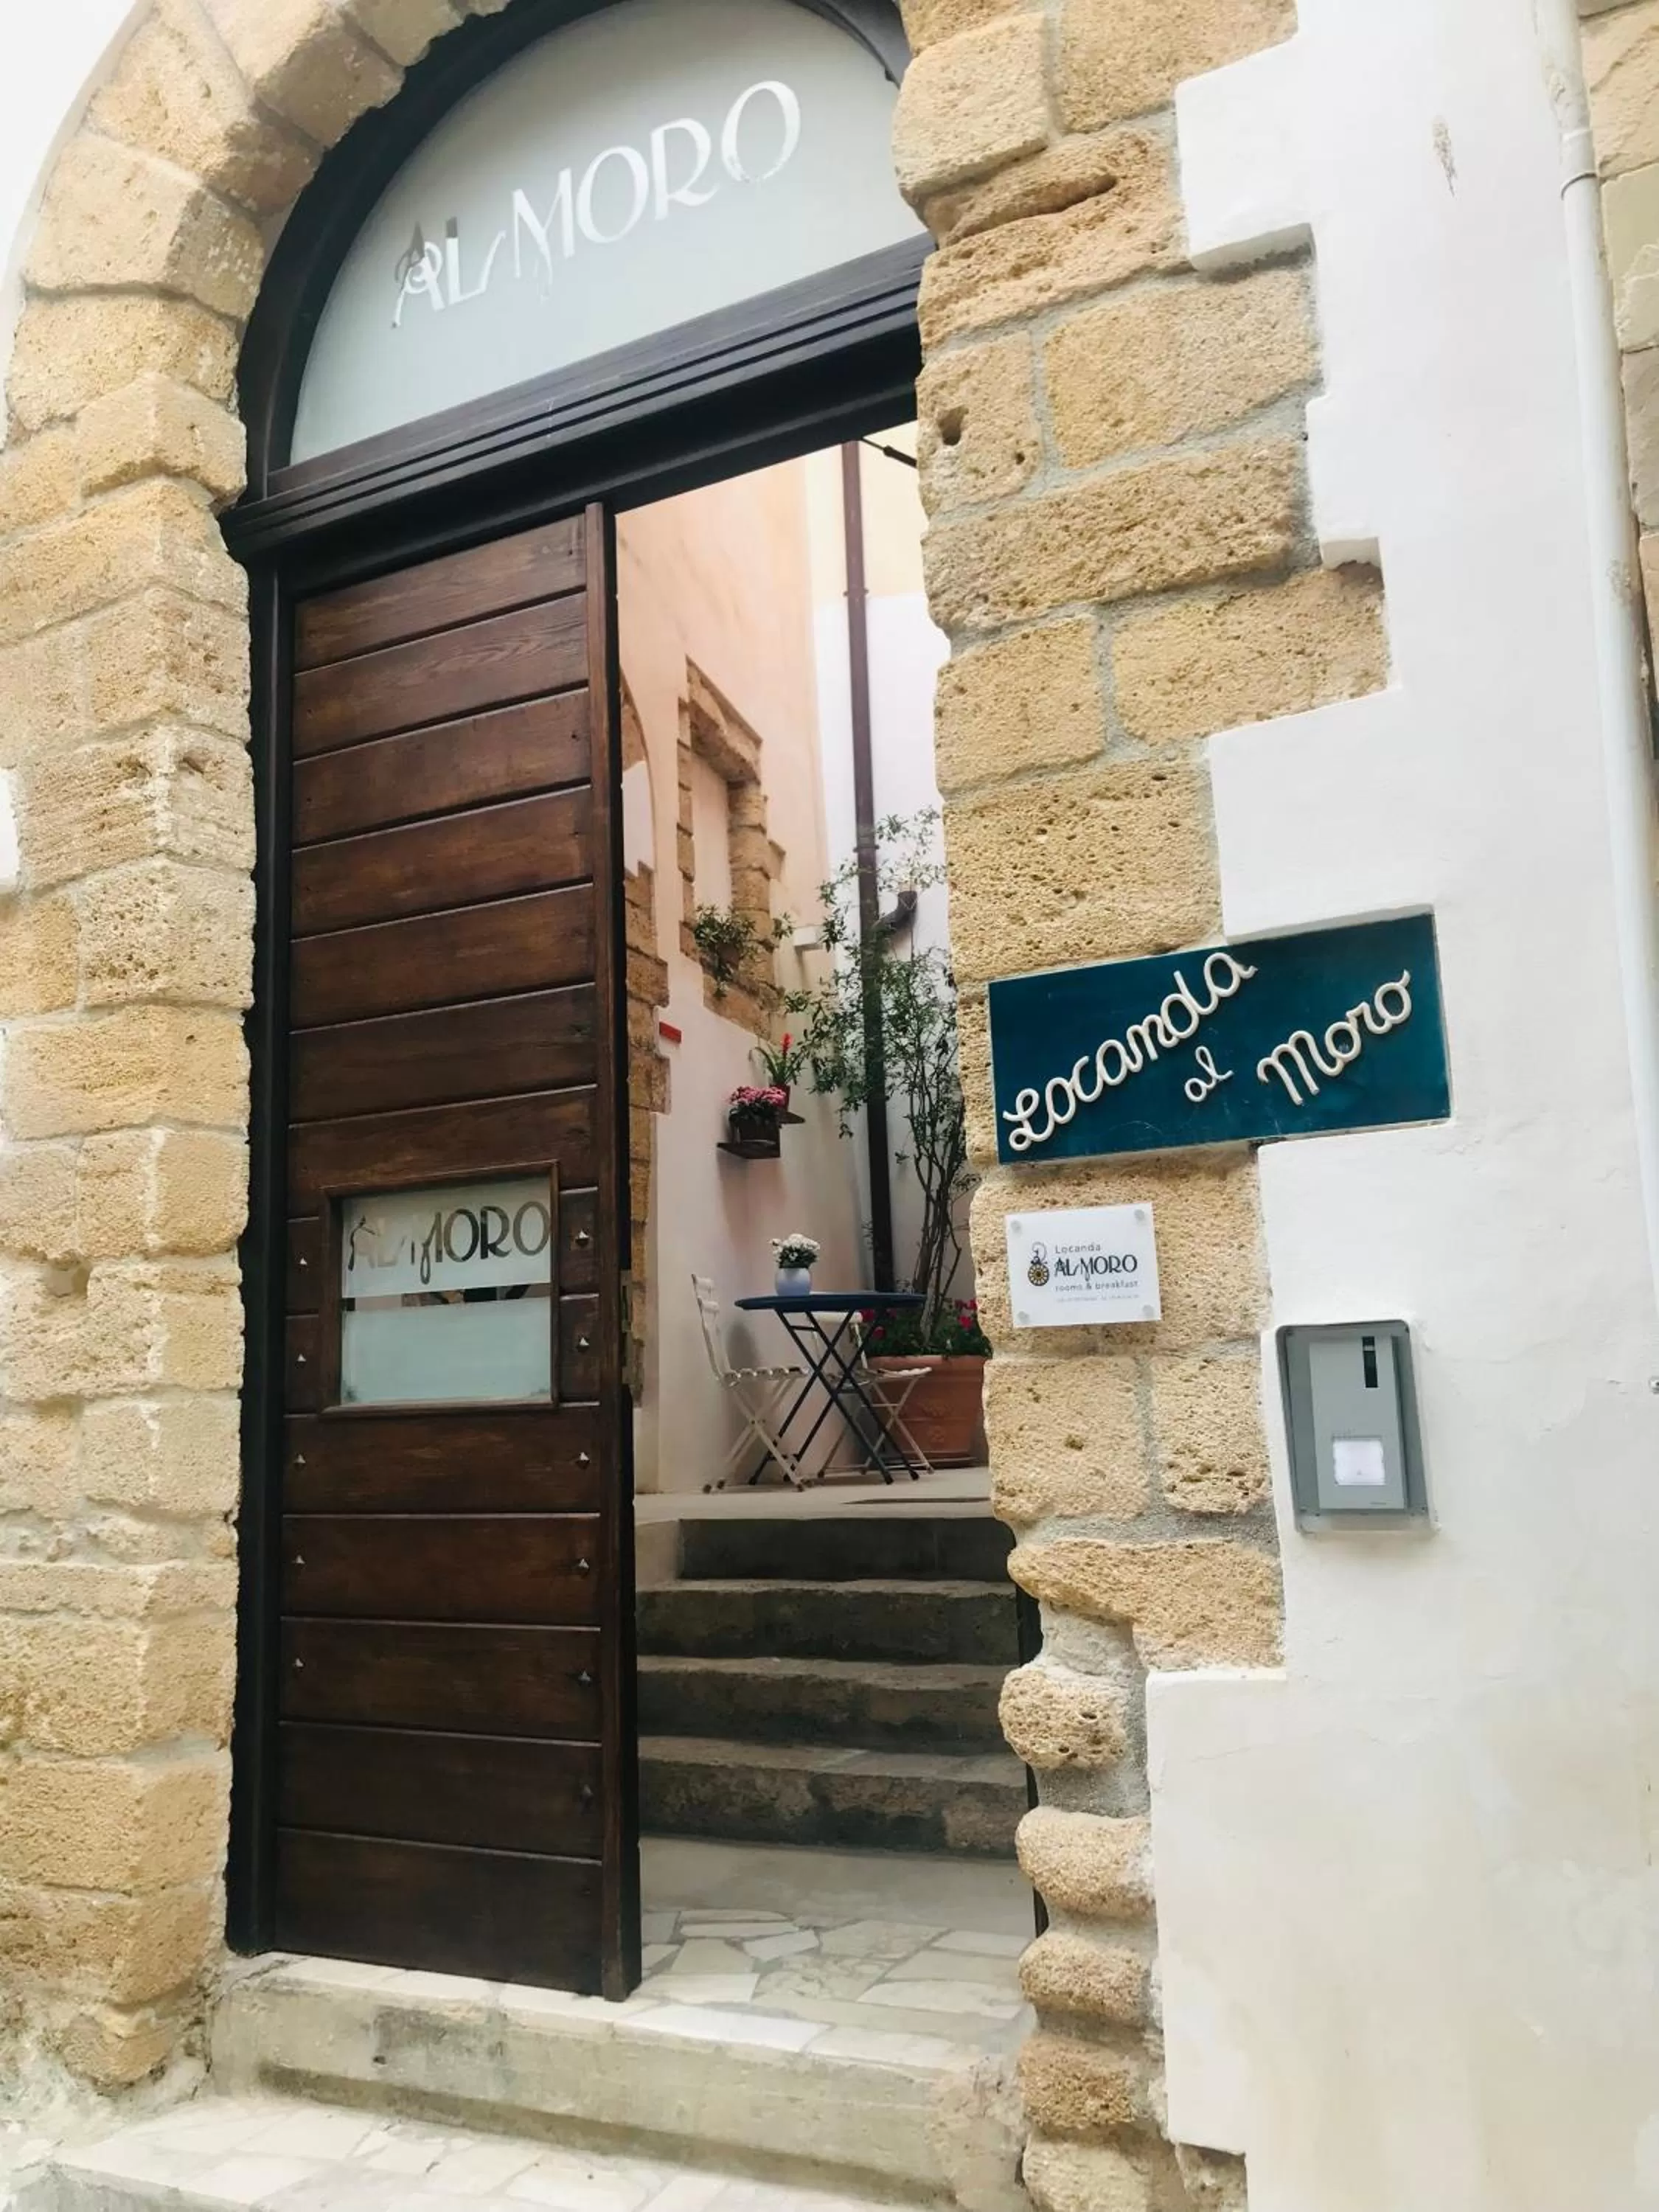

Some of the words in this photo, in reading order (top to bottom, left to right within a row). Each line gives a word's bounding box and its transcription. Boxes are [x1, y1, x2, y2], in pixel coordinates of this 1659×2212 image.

[1002, 951, 1259, 1152] Locanda
[1184, 1046, 1234, 1103] al
[1256, 969, 1411, 1106] Moro
[1055, 1243, 1102, 1254] Locanda
[1055, 1284, 1083, 1292] rooms
[1086, 1281, 1092, 1290] &
[1095, 1279, 1138, 1290] breakfast
